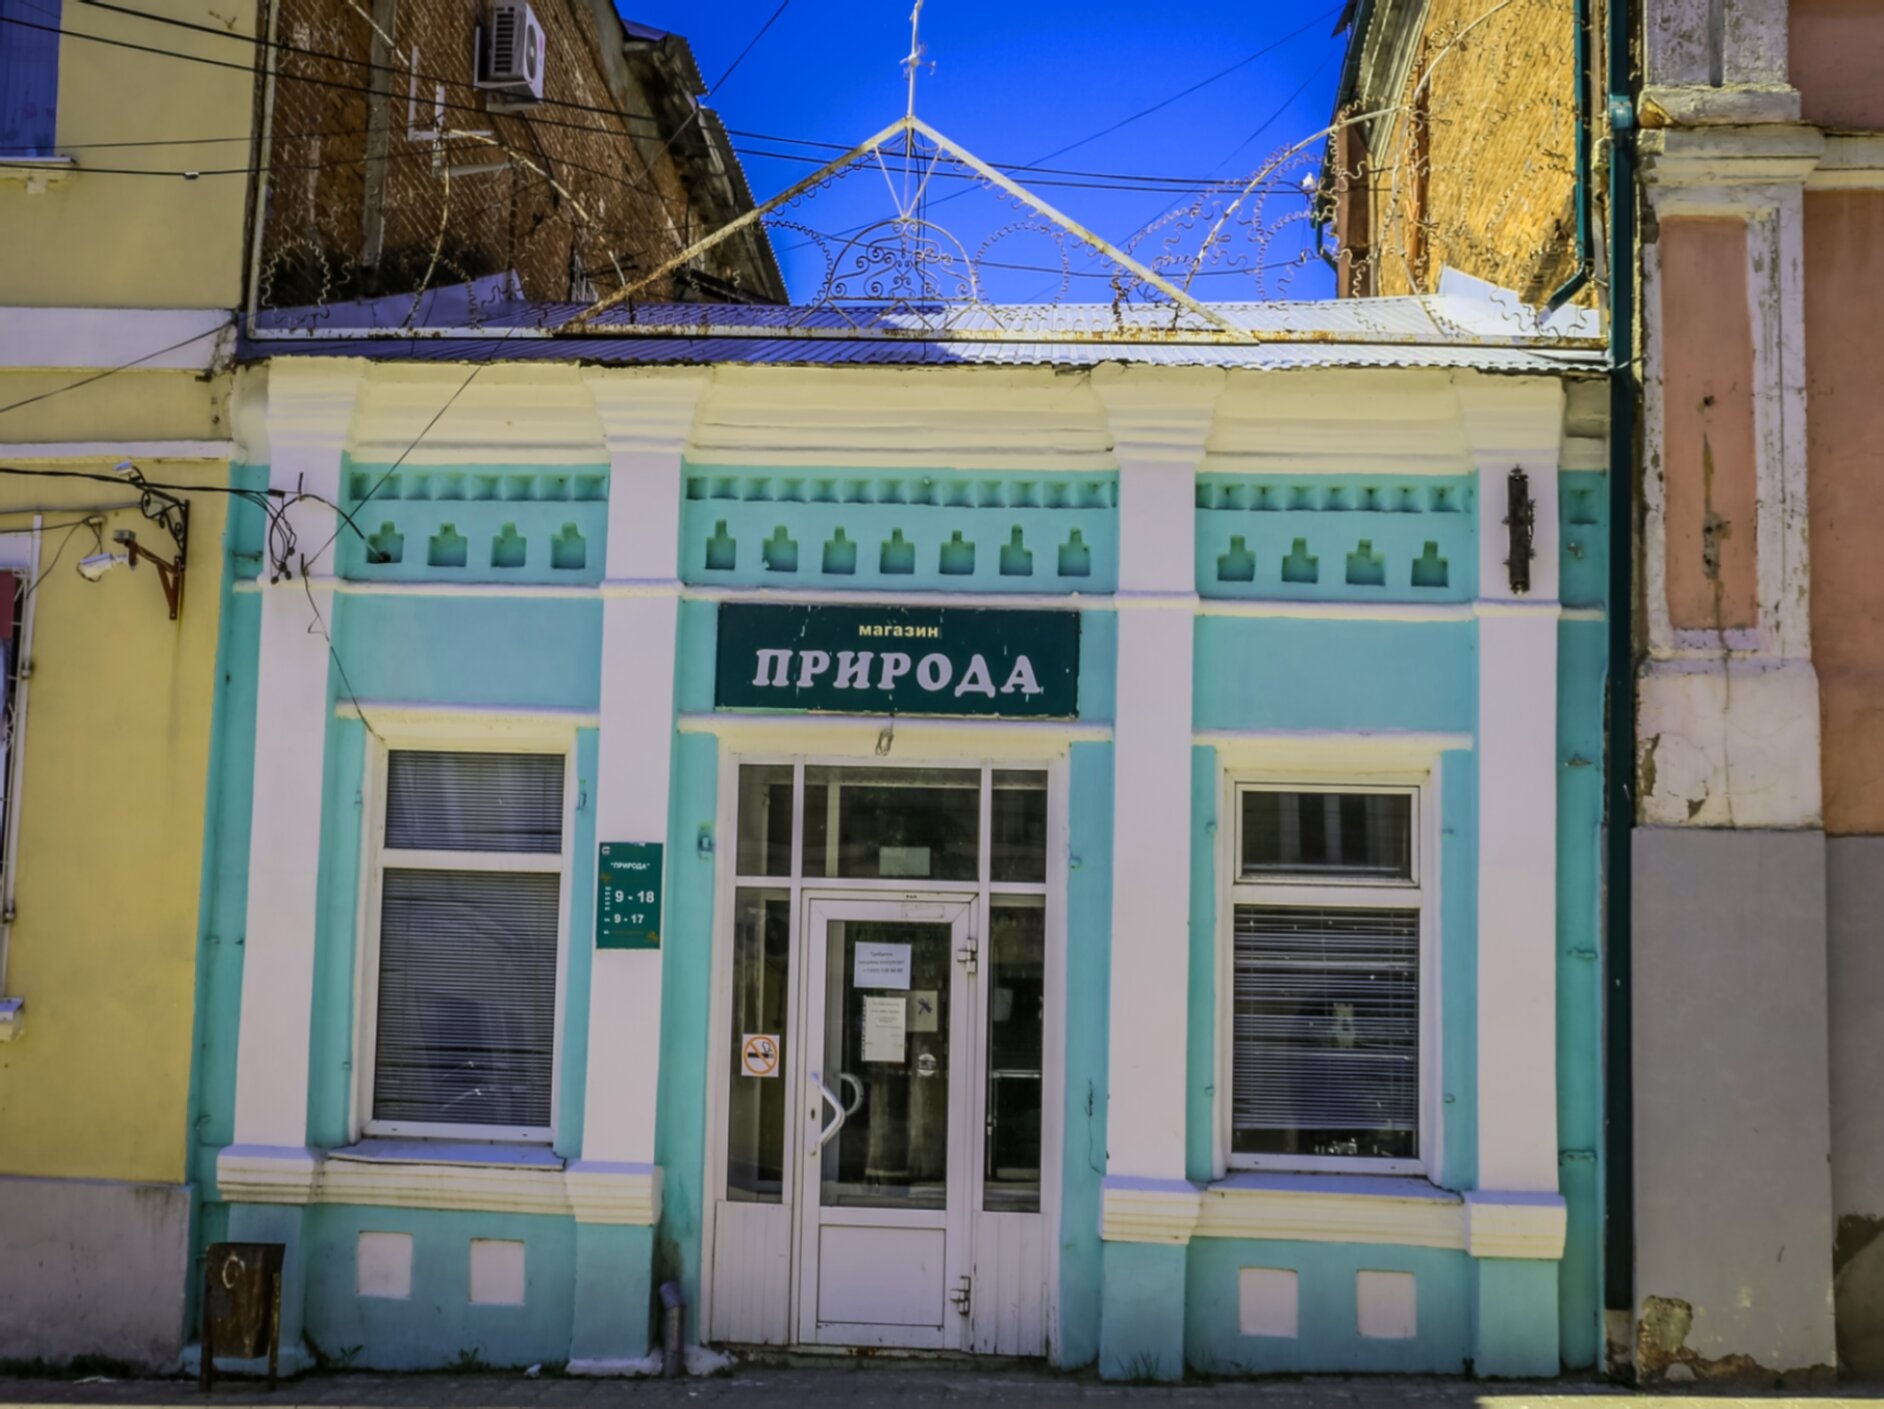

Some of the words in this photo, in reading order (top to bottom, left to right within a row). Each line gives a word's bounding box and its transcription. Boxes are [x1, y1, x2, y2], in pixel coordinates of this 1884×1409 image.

[858, 622, 940, 639] магазин
[752, 648, 1041, 699] ПРИРОДА
[614, 890, 624, 903] 9
[637, 890, 655, 903] 18
[613, 913, 621, 924] 9
[630, 913, 645, 924] 17
